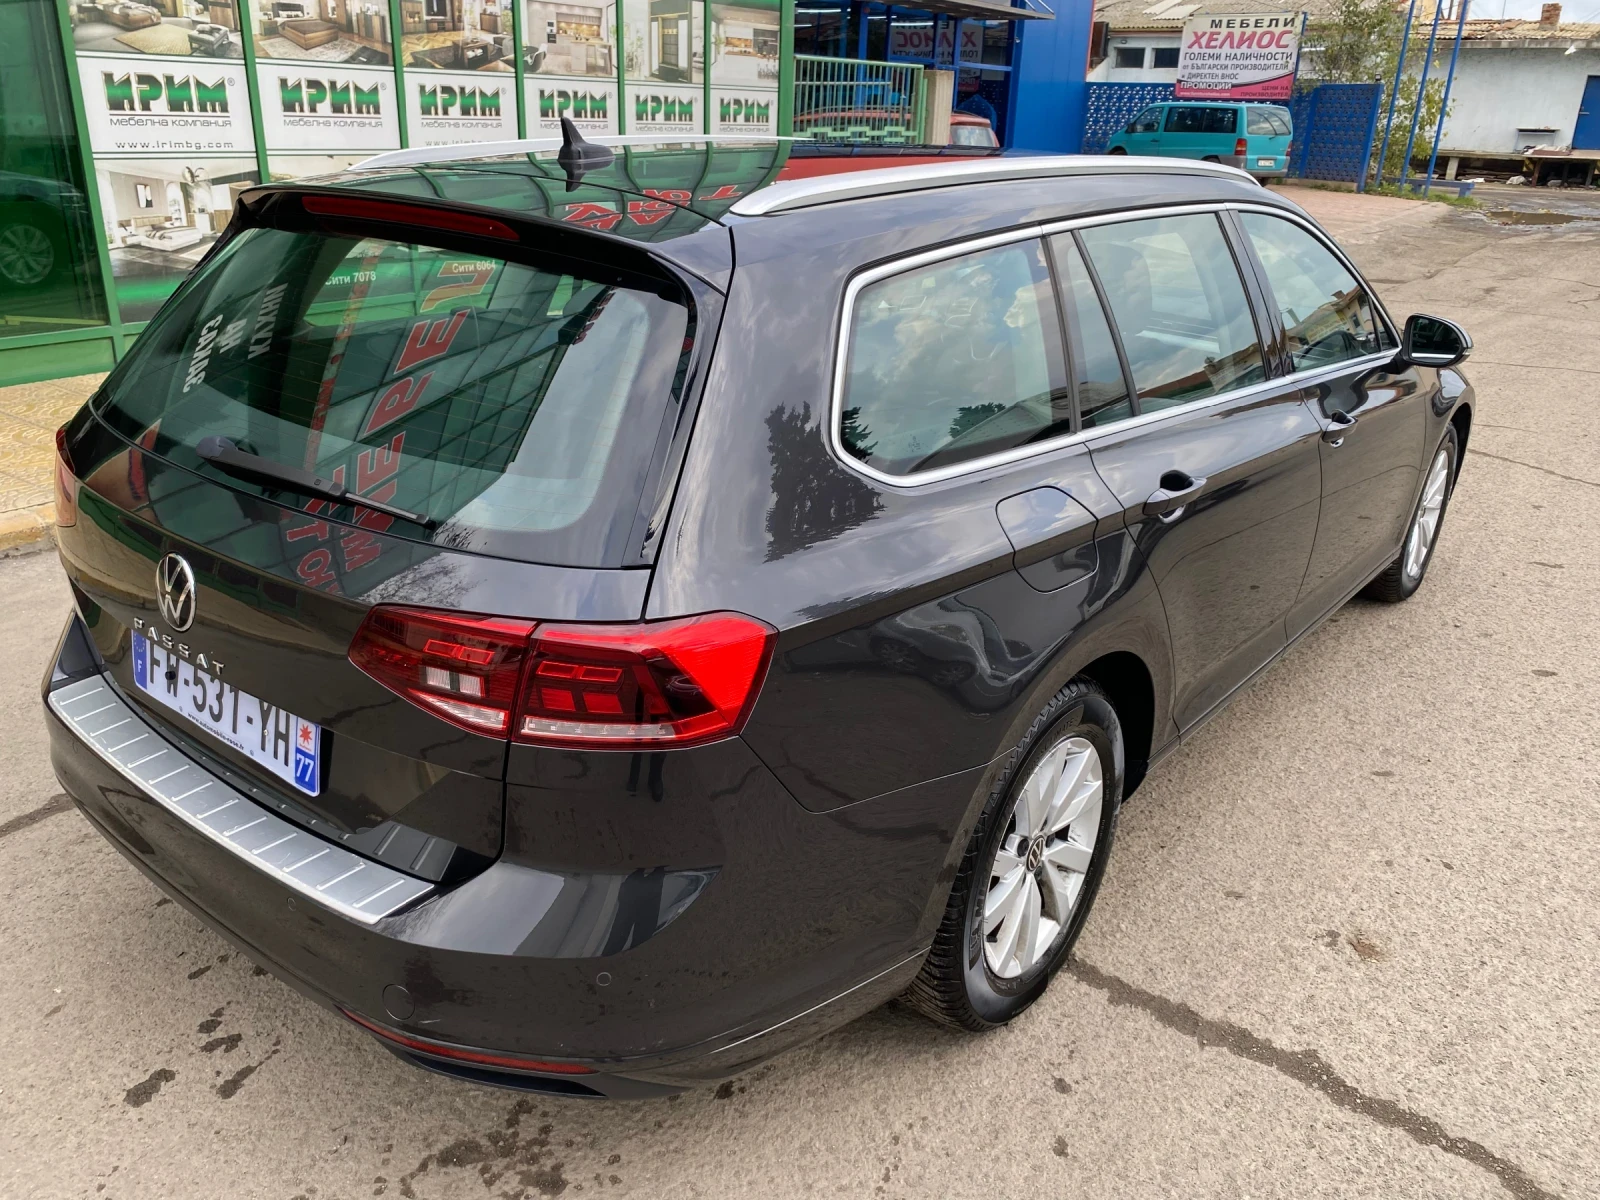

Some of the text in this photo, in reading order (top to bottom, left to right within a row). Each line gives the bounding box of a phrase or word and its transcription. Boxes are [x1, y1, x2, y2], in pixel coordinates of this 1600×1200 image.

[1210, 17, 1296, 29] МЕБЕЛИ
[1187, 29, 1293, 49] ХЕЛИОС
[1184, 51, 1293, 61] ГОЛЕМИ НАЛИЧНОСТИ
[1230, 63, 1289, 71] ПРОИЗВОДИТЕЛИ
[1187, 72, 1220, 80] ДИРЕКТЕН
[1221, 72, 1239, 80] ВНОС
[101, 71, 229, 113] ИРИМ
[1180, 81, 1232, 90] ПРОМОЦИИ
[278, 76, 381, 115] ИРИМ
[418, 83, 501, 116] ИРИМ
[539, 88, 607, 119] ИРИМ
[635, 93, 693, 122] ИРИМ
[720, 97, 770, 123] ИРИМ
[110, 117, 232, 128] мебелна компания
[283, 117, 383, 128] мебелна компания
[421, 120, 503, 129] мебелна компания
[115, 140, 234, 150] www.irimbg.com
[452, 259, 496, 273] Сити 6064
[352, 271, 376, 283] 7078
[133, 617, 225, 676] PASSAT
[149, 640, 291, 768] FW-531-YH
[295, 752, 315, 783] 77
